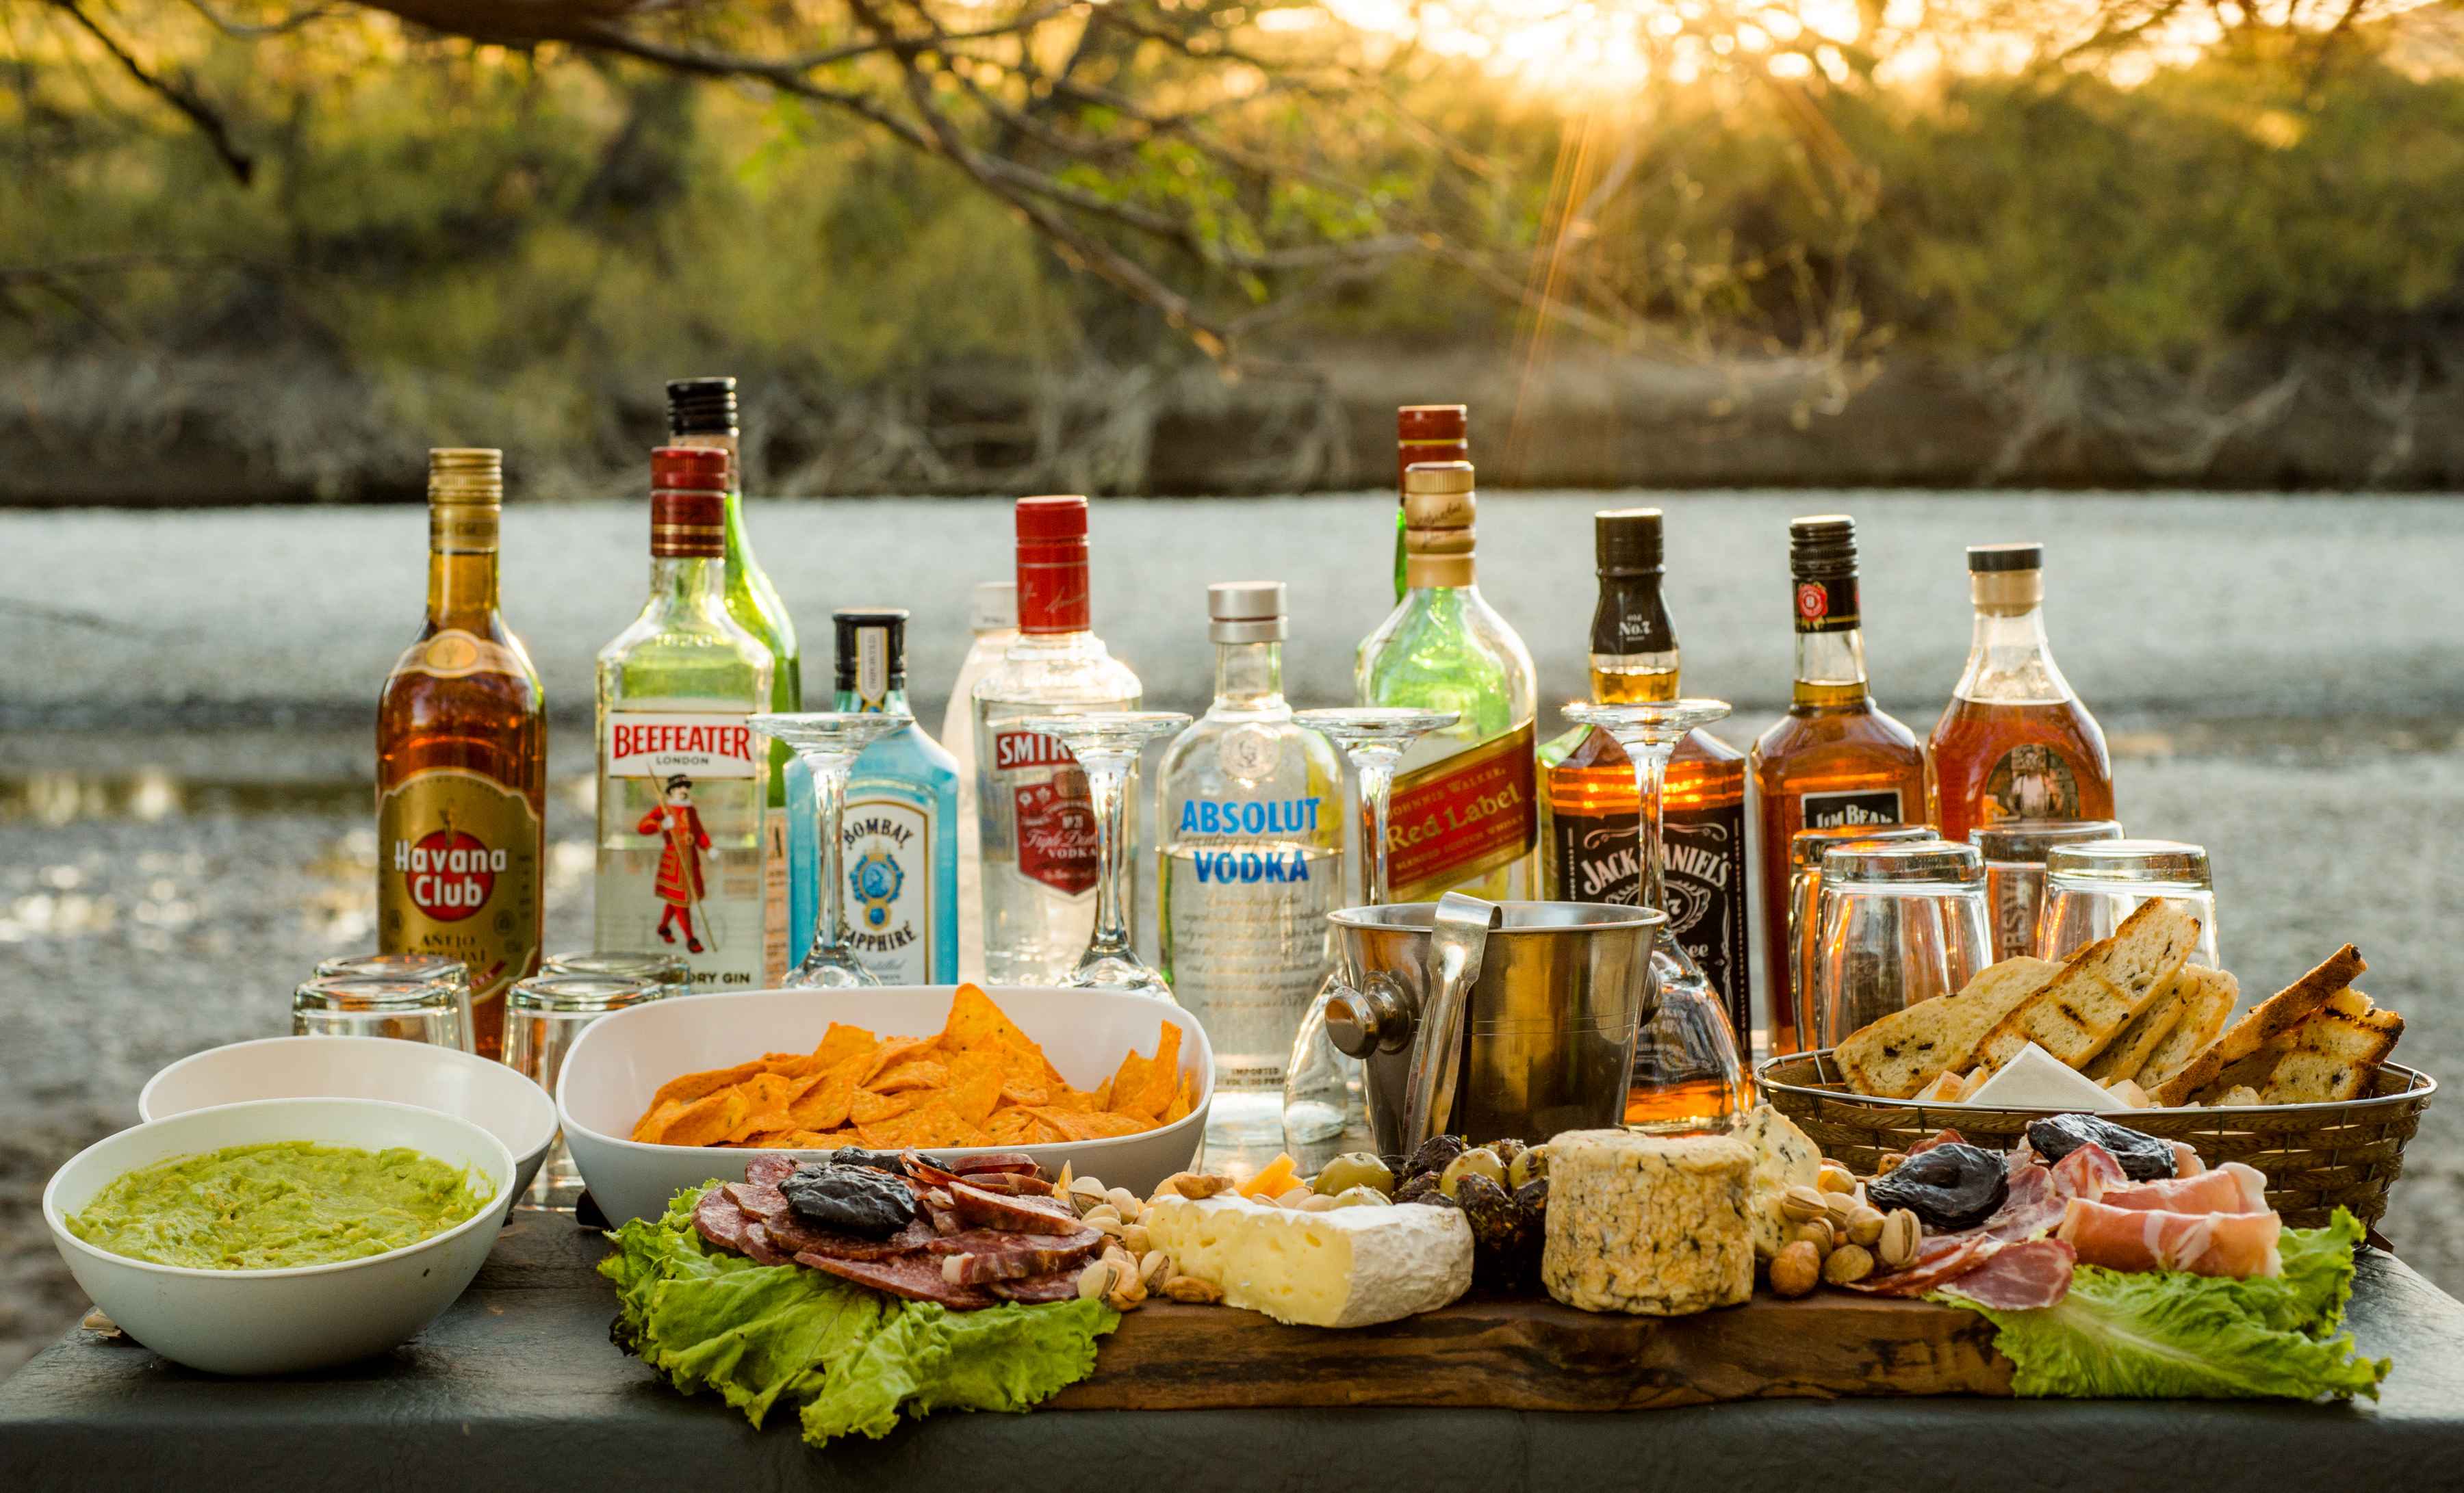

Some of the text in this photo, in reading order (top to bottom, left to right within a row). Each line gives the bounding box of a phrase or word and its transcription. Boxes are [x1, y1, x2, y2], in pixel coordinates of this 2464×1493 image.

[613, 723, 751, 762] BEEFEATER
[999, 734, 1070, 766] SMIR
[656, 755, 709, 766] LONDON
[1180, 797, 1320, 834] ABSOLUT
[1387, 781, 1523, 855] Red Label
[843, 818, 914, 851] BOMBAY
[394, 840, 507, 873] Havana
[1194, 848, 1310, 884] VODKA
[1580, 847, 1640, 895] JACK
[413, 875, 484, 907] Club
[722, 972, 751, 985] GIN
